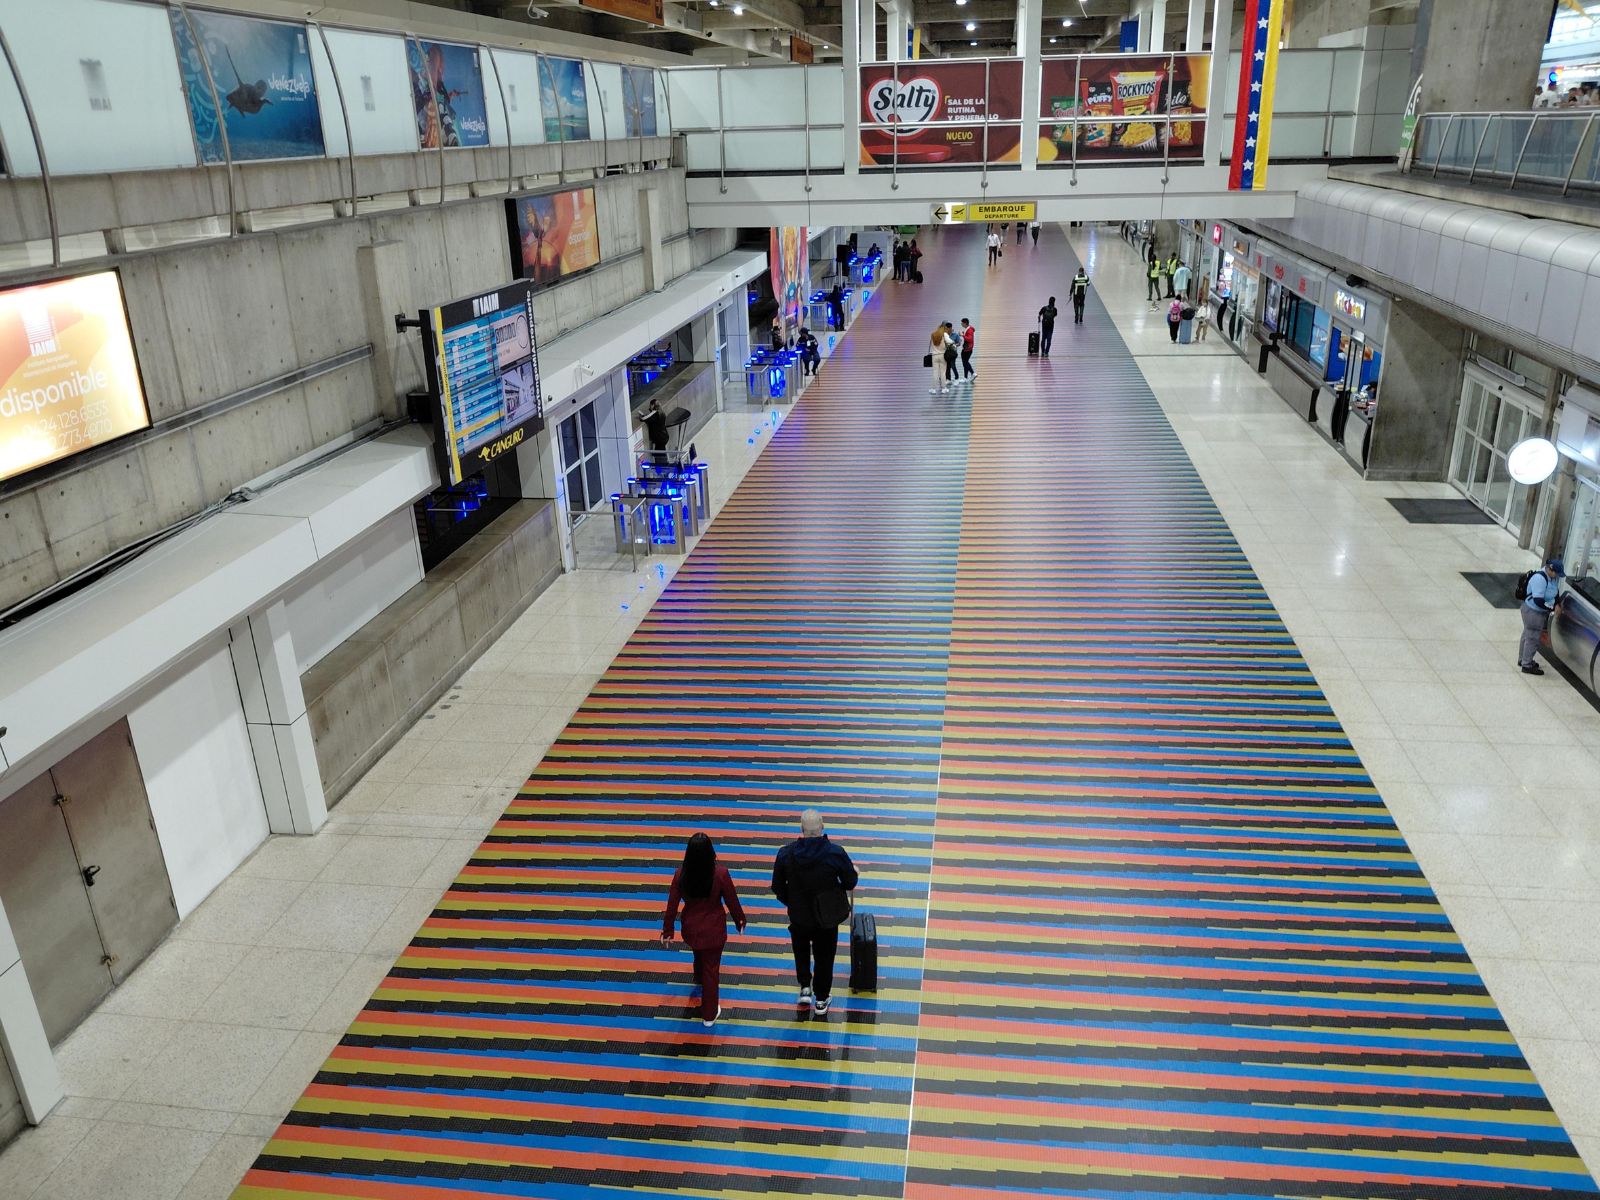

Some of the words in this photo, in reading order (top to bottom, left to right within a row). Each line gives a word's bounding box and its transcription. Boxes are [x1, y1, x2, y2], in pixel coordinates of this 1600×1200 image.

[1118, 81, 1155, 98] ROCKYTOS
[873, 85, 936, 122] Salty
[947, 98, 963, 106] SAL
[947, 106, 976, 114] RUTINA
[946, 131, 973, 141] NUEVO
[978, 205, 1026, 213] EMBARQUE
[0, 367, 109, 417] disponible
[490, 427, 524, 458] CANGURO
